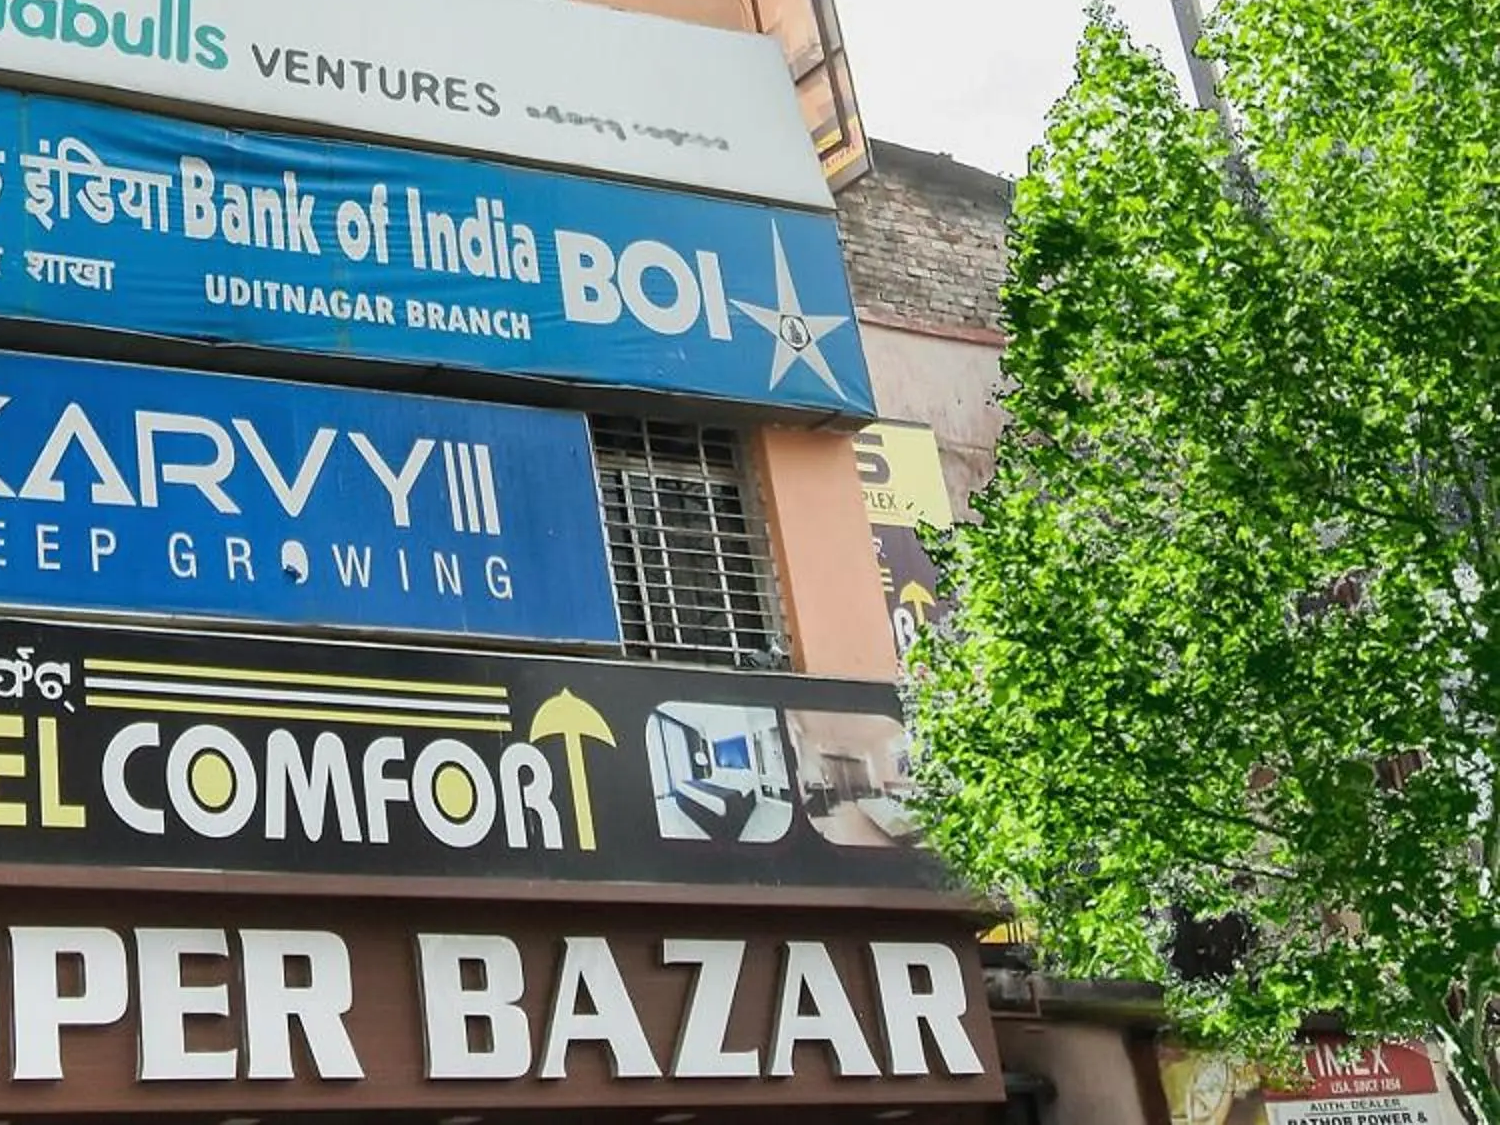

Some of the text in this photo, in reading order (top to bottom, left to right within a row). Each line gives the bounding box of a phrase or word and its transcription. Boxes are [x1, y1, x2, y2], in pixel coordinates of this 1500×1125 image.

[251, 43, 502, 118] VENTURES
[20, 136, 173, 233] इंडिया
[179, 155, 541, 285] Bank of India
[25, 249, 115, 291] शाखा
[205, 274, 532, 340] UDITNAGAR BRANCH
[555, 229, 733, 342] BOI
[416, 932, 987, 1079] BAZAR
[1351, 1098, 1401, 1110] DEALER
[1356, 1111, 1412, 1125] POWER
[1417, 1111, 1428, 1124] &
